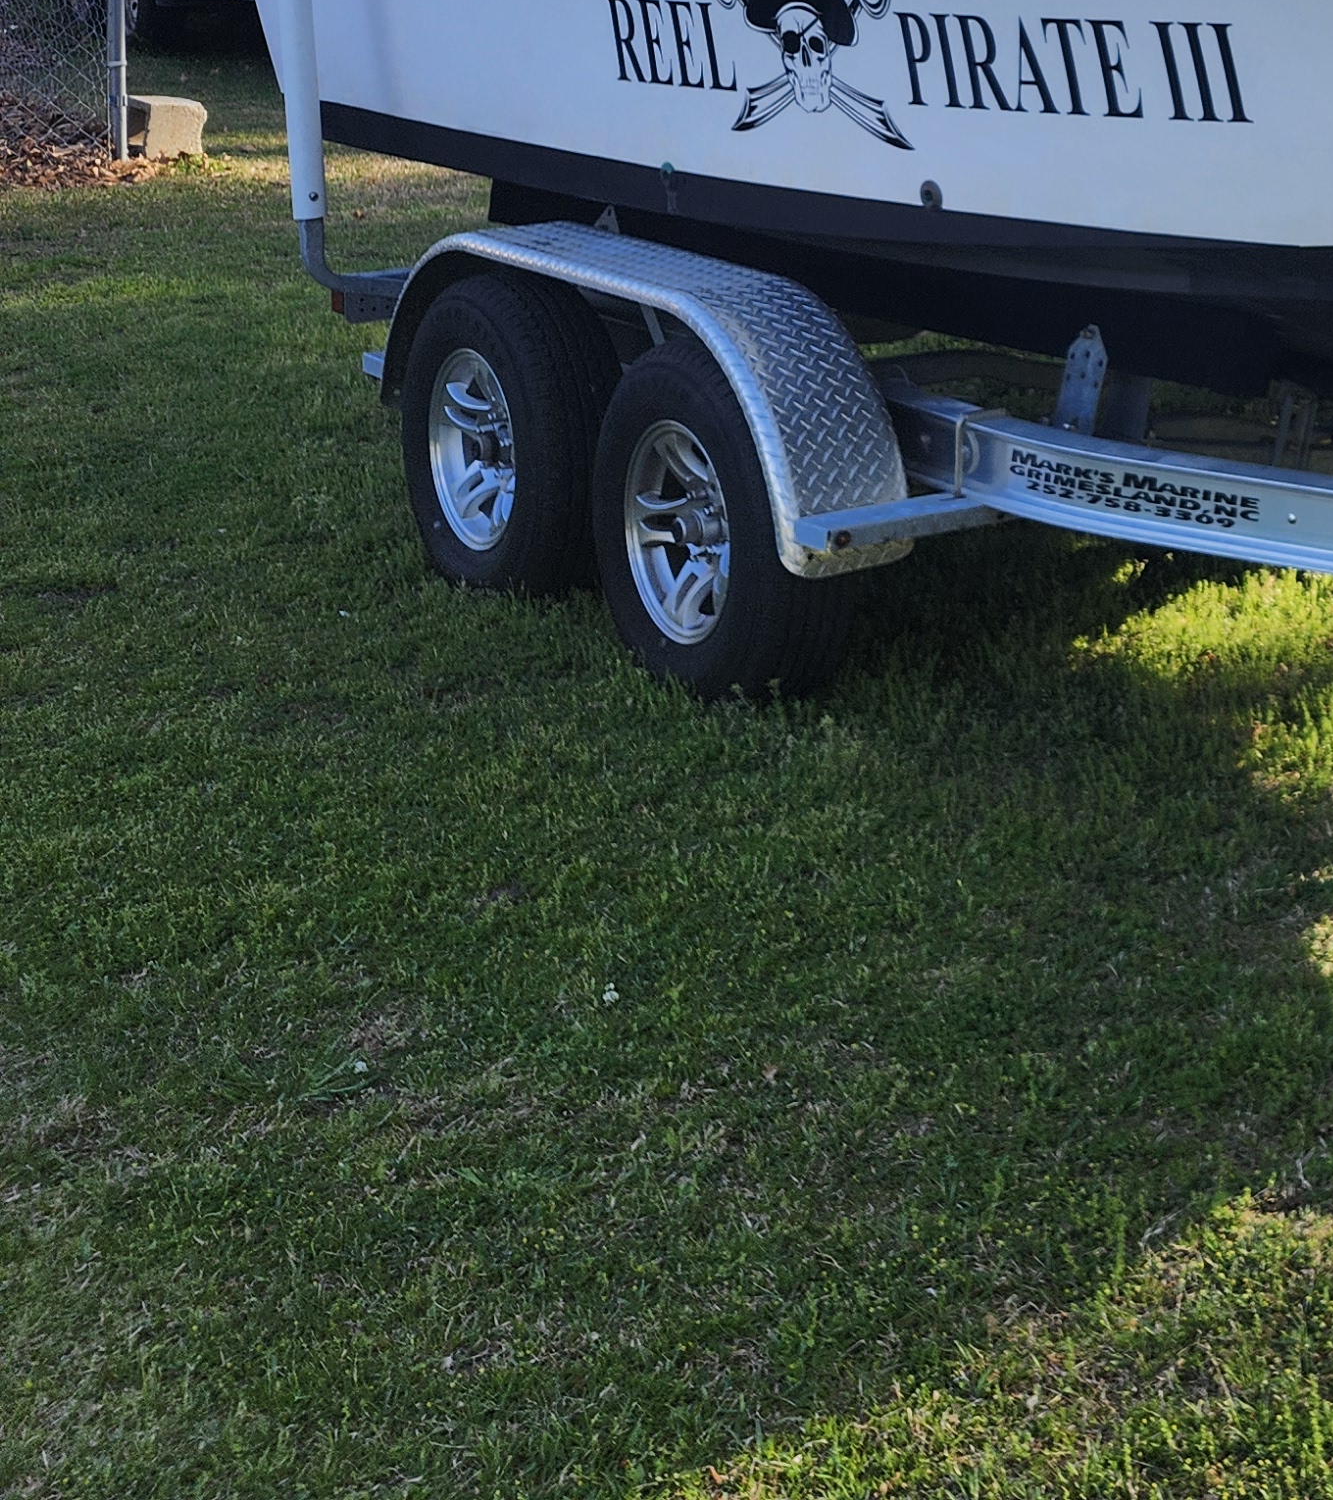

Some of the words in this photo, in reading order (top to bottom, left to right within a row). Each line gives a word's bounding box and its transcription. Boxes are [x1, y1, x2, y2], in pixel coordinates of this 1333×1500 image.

[893, 11, 1144, 119] PIRATE
[1148, 19, 1254, 124] III
[1122, 471, 1260, 510] MARINE
